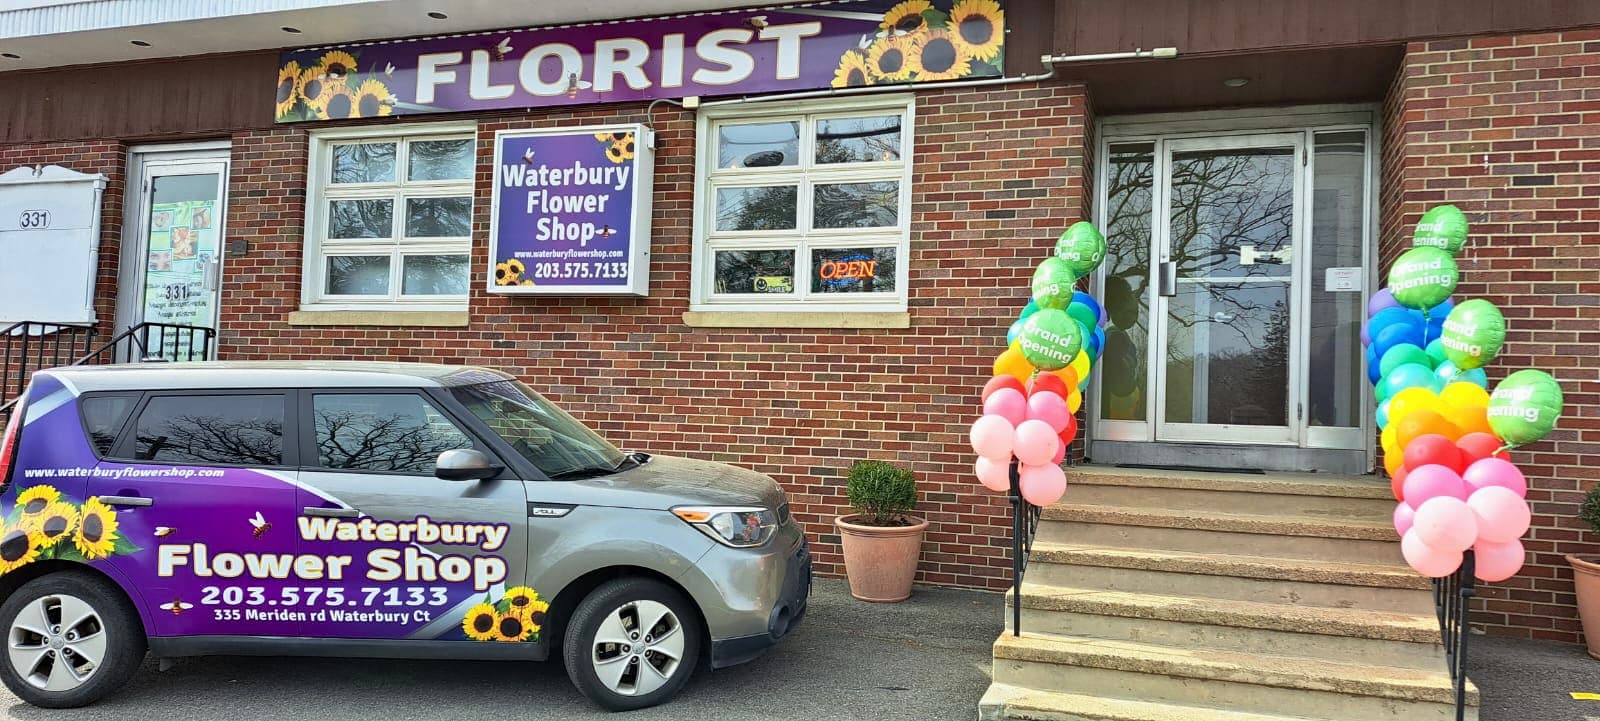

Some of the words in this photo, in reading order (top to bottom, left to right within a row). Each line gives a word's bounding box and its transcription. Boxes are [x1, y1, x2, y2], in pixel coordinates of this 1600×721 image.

[415, 22, 822, 105] FLORIST
[502, 160, 630, 190] Waterbury
[527, 189, 609, 214] Flower
[21, 212, 47, 228] 331
[535, 216, 595, 247] Shop
[514, 249, 623, 260] www.waterburyflowershop.com
[535, 262, 628, 279] 203.575.7133
[820, 259, 876, 280] OPEN
[165, 285, 188, 300] 331
[24, 467, 225, 480] www.waterburyflowershop.com
[297, 515, 509, 550] Waterbury
[156, 543, 352, 581] Flower
[365, 547, 508, 591] Shop
[200, 586, 449, 607] 203.575.7133
[214, 608, 241, 621] 335
[245, 608, 306, 622] Meriden
[310, 609, 326, 622] rd
[329, 610, 410, 626] Waterbury
[413, 609, 431, 623] Ct
